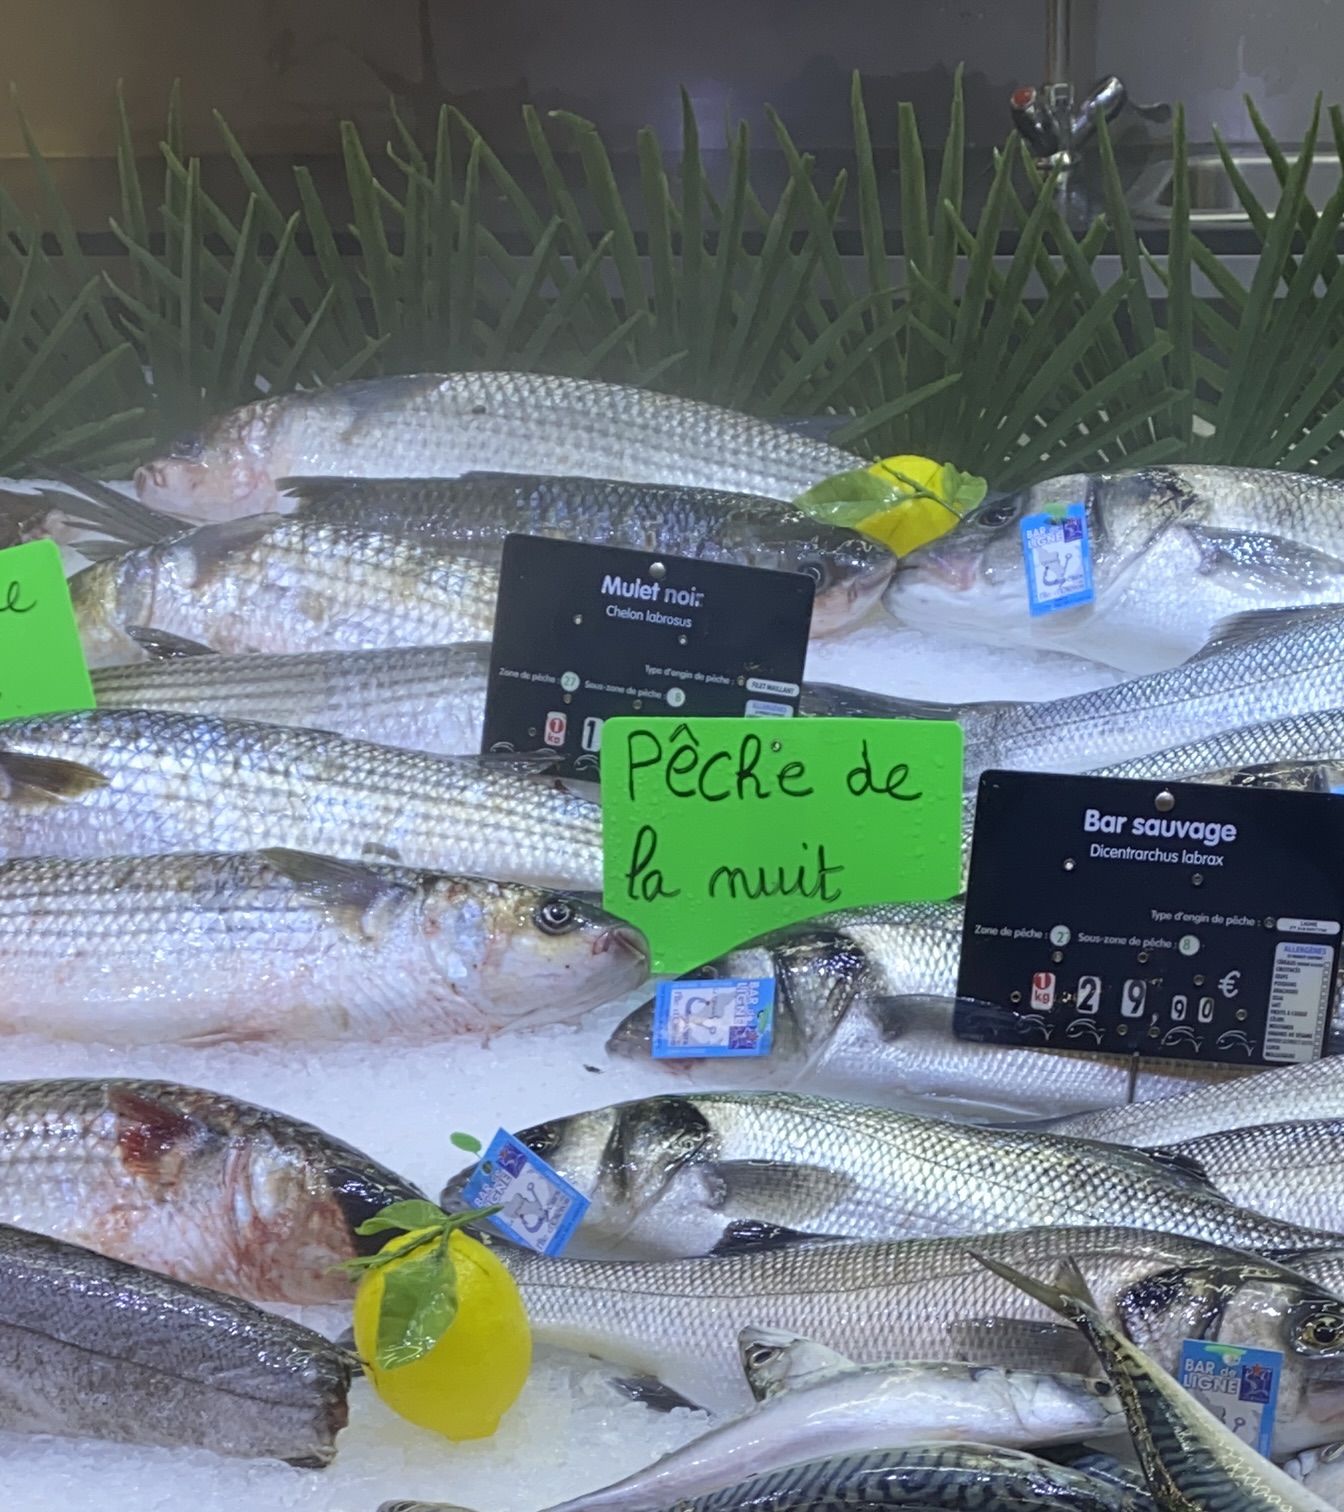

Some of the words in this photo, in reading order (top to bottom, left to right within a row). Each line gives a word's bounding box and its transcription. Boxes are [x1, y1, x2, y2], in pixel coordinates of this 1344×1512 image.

[601, 574, 661, 602] Mulet
[606, 604, 645, 622] Chelon
[645, 609, 693, 629] labrosus
[627, 722, 814, 802] Pêche
[846, 738, 923, 801] de
[1083, 808, 1127, 835] Bar
[1131, 813, 1238, 846] sauvage
[624, 823, 682, 901] la
[708, 841, 846, 902] nuit
[1089, 842, 1179, 864] Dicentrarchus
[1181, 849, 1224, 867] labrax
[1150, 909, 1171, 923] Type
[1173, 910, 1211, 925] d'engin
[1212, 914, 1225, 924] de
[1227, 914, 1256, 929] pêche
[974, 925, 997, 937] Zone
[999, 926, 1013, 937] de
[1013, 927, 1044, 940] pêche
[1077, 932, 1126, 947] Sous-zone
[1128, 936, 1140, 946] de
[1140, 936, 1173, 951] pêche
[1182, 938, 1191, 951] 8
[1217, 970, 1241, 998] €
[1034, 990, 1051, 1004] kg
[484, 1173, 513, 1208] IGNE
[1185, 1358, 1216, 1373] BAR
[1220, 1367, 1237, 1378] de
[1182, 1374, 1239, 1395] LIGNE
